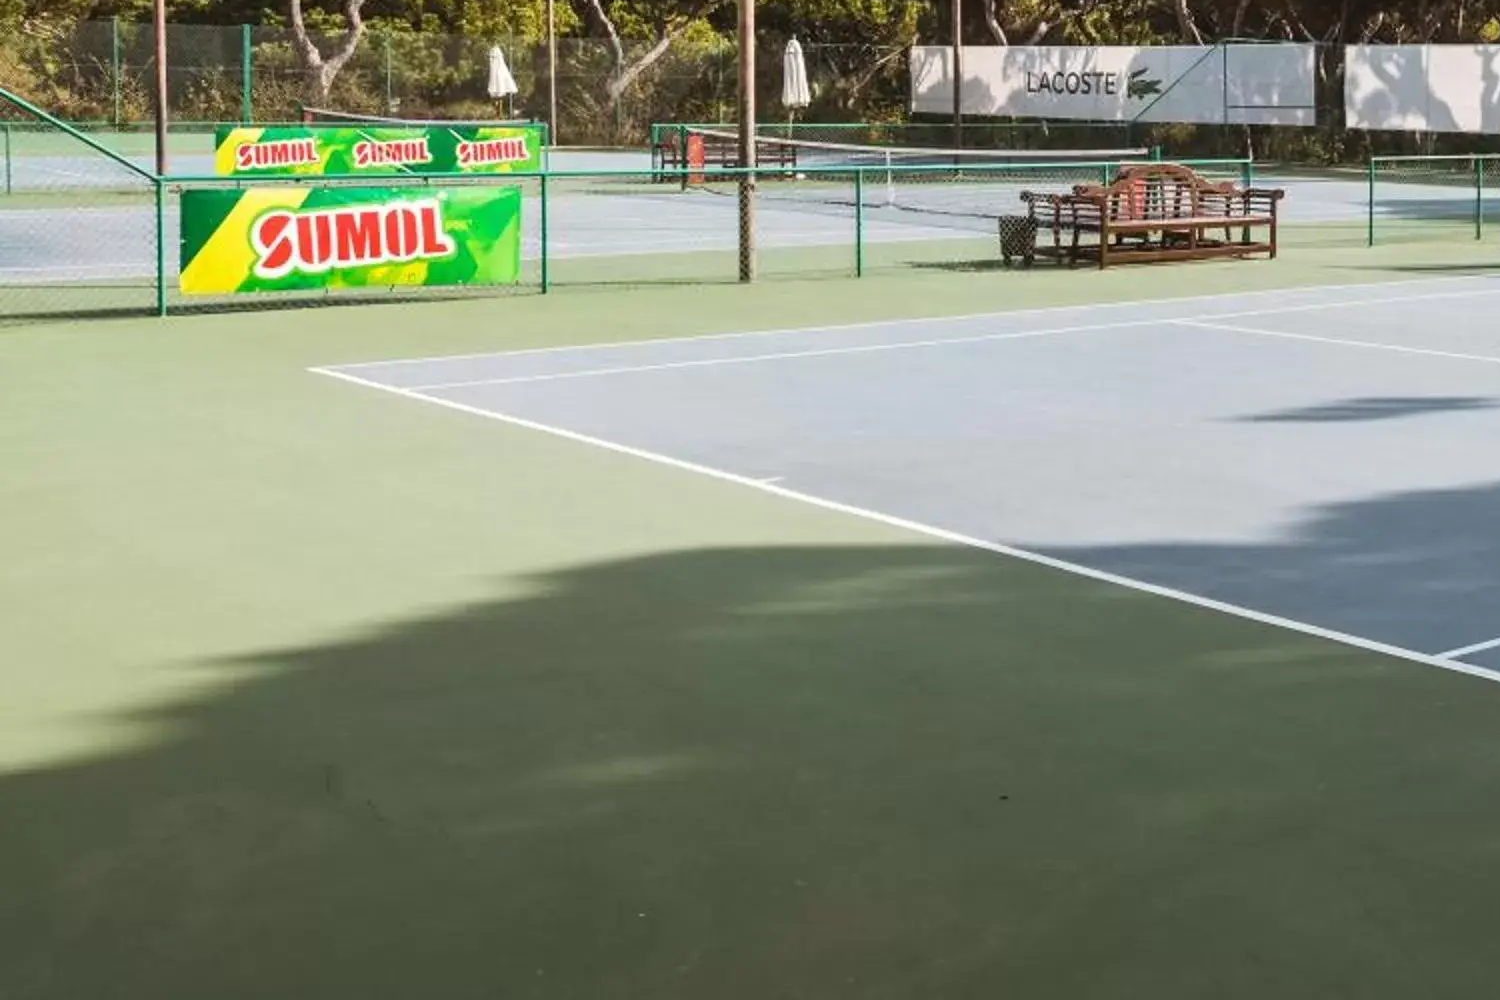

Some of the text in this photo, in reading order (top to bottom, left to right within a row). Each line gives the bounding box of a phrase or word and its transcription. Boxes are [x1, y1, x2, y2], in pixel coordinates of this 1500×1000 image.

[1026, 71, 1117, 95] LACOSTE
[238, 138, 528, 168] SUMOL SUMOL SUMOL
[257, 206, 450, 270] SUMOL
